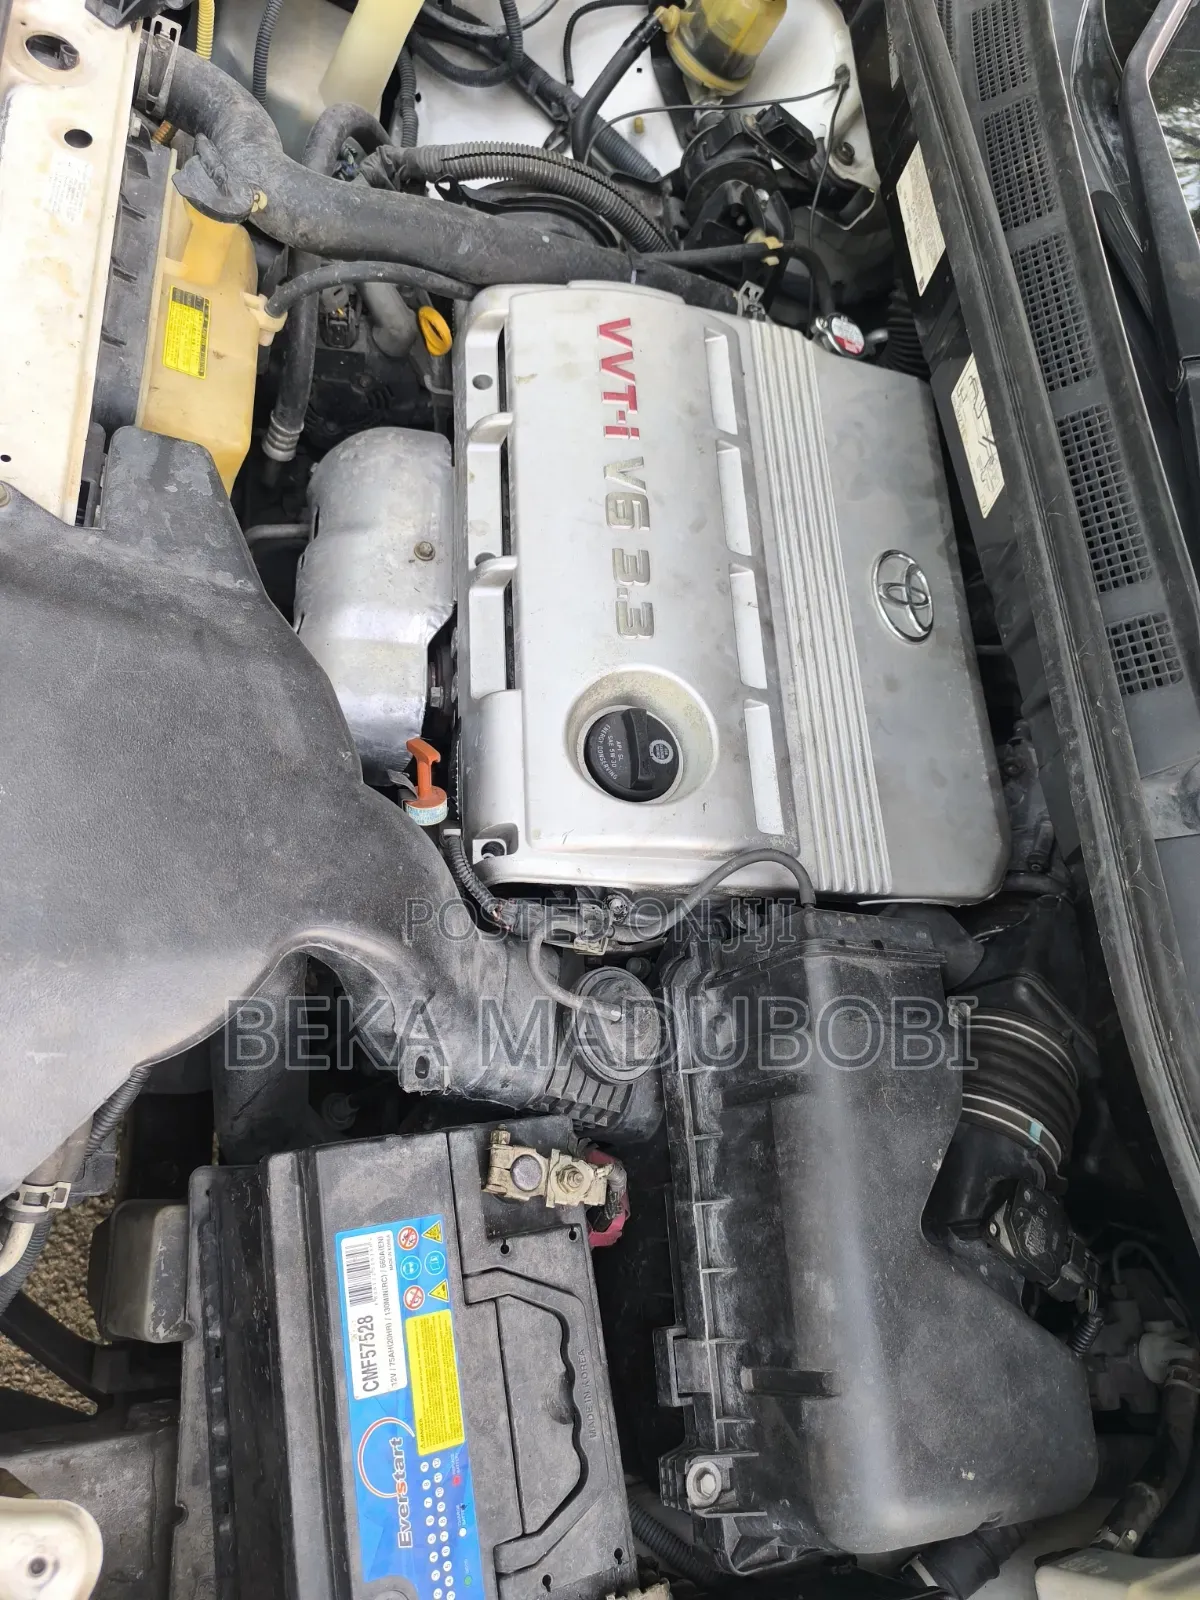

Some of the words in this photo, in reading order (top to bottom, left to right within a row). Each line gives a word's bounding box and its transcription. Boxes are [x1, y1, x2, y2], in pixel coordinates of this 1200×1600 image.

[597, 317, 640, 440] VVT-i
[603, 456, 650, 532] V6
[612, 548, 654, 639] 3.3
[598, 723, 611, 743] ENERGY
[597, 746, 618, 780] CONSERVING
[381, 1274, 391, 1315] 130MIN(RC)
[357, 1315, 380, 1392] CMF57528
[385, 1322, 396, 1367] 75AH(20HR)
[390, 1373, 398, 1387] 12V
[578, 1348, 590, 1388] KOREA
[583, 1391, 592, 1403] IN
[585, 1405, 597, 1439] MADE
[390, 1437, 413, 1548] Everstart
